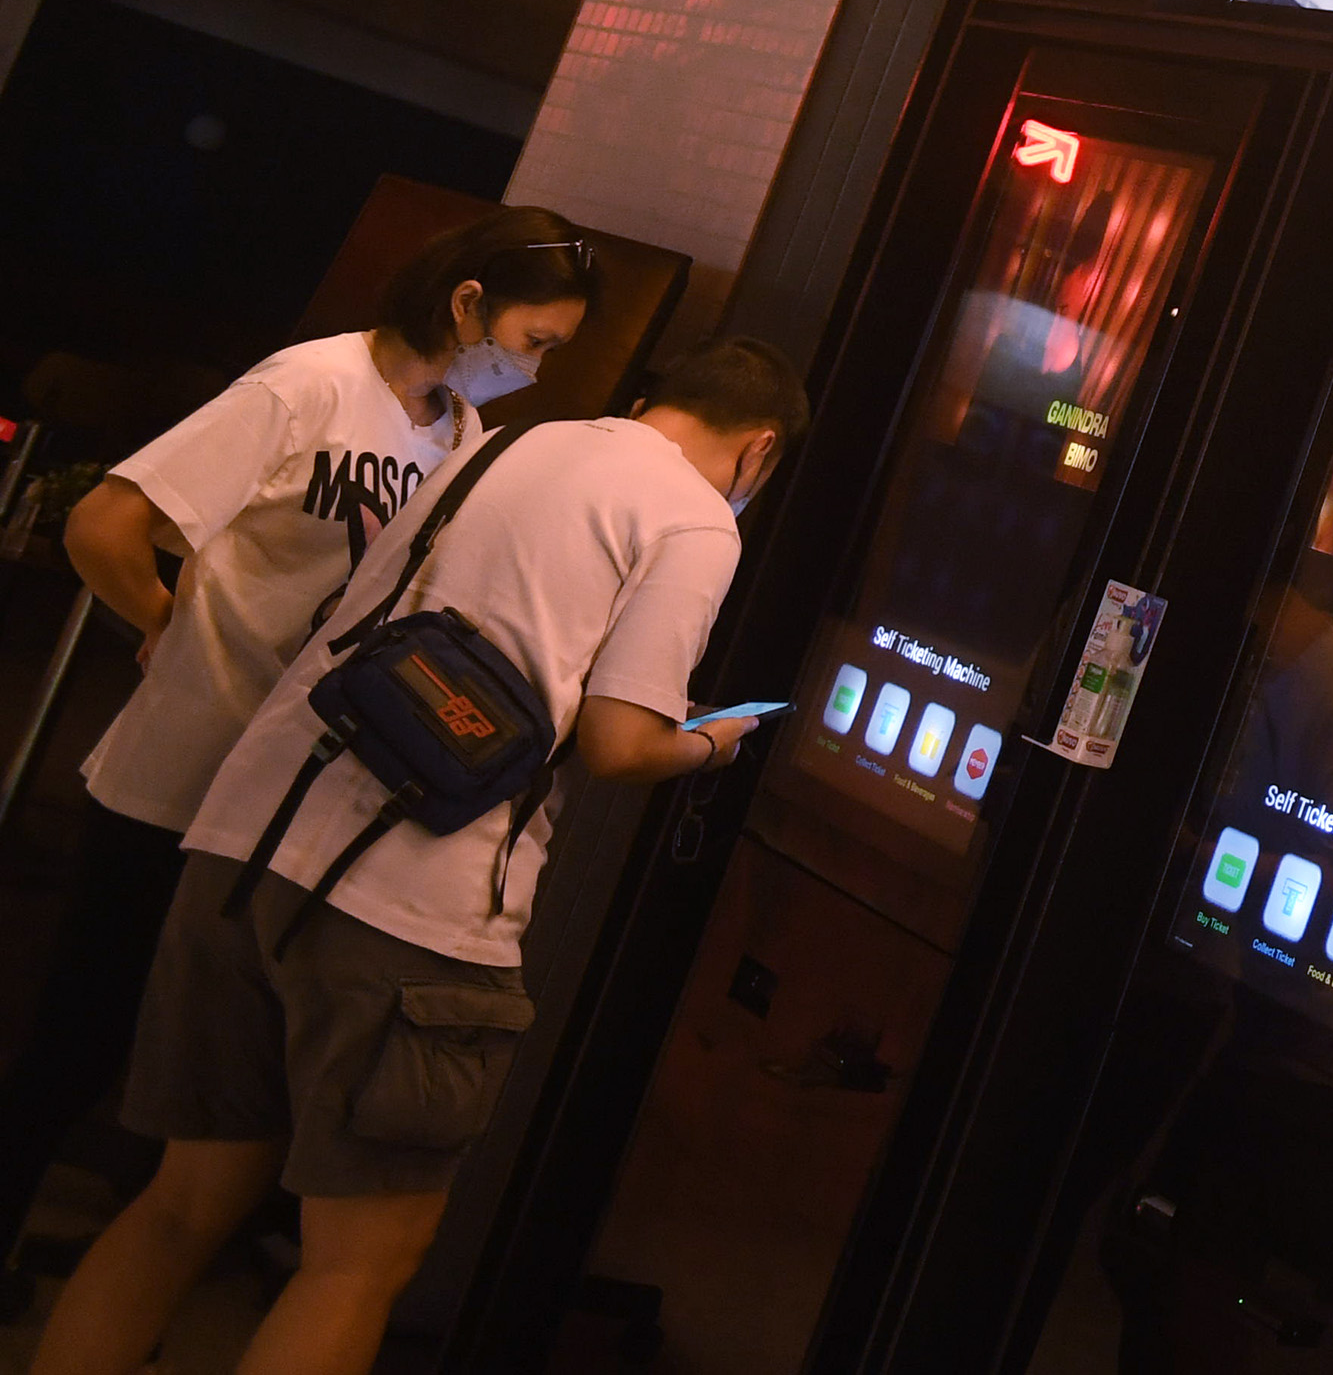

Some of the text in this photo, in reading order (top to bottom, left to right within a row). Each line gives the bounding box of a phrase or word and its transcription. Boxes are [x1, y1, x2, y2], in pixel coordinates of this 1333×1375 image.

[1047, 400, 1110, 439] GANINDRA
[1064, 442, 1099, 473] BIMO
[873, 625, 992, 692] Self Ticketing Machine
[1264, 784, 1299, 815] Self
[1196, 911, 1231, 936] Buy Ticket
[1252, 938, 1297, 968] Collect Ticket
[1306, 964, 1326, 982] Food
